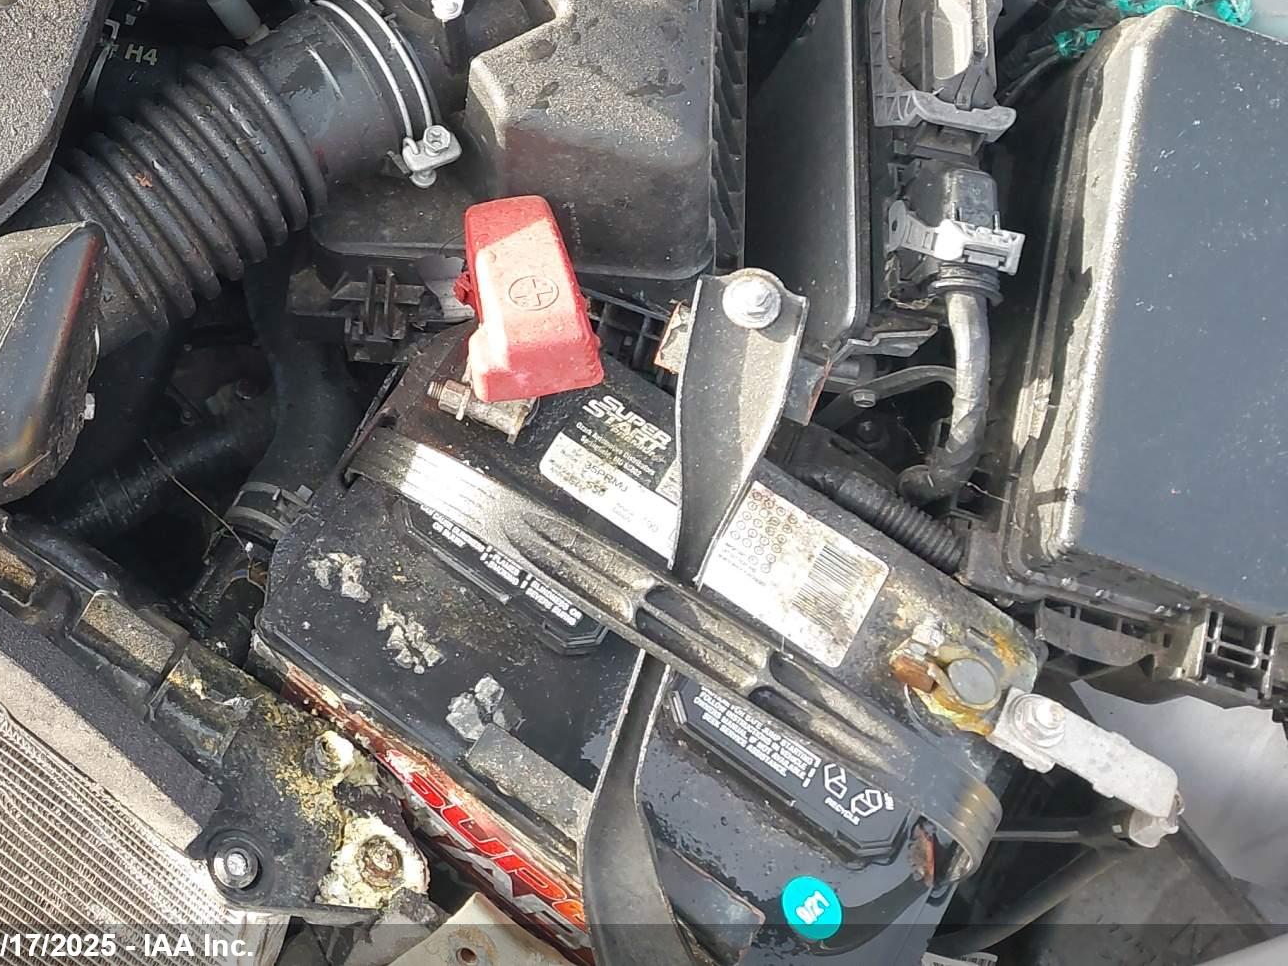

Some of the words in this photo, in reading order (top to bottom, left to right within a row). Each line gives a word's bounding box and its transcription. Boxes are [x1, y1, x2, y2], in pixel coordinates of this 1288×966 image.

[124, 43, 158, 66] H4
[576, 422, 592, 435] Ozark
[583, 400, 667, 457] START
[599, 396, 671, 447] SUPER
[569, 608, 582, 619] OR
[699, 692, 727, 713] FOLLOW
[825, 797, 860, 825] RECYCLE
